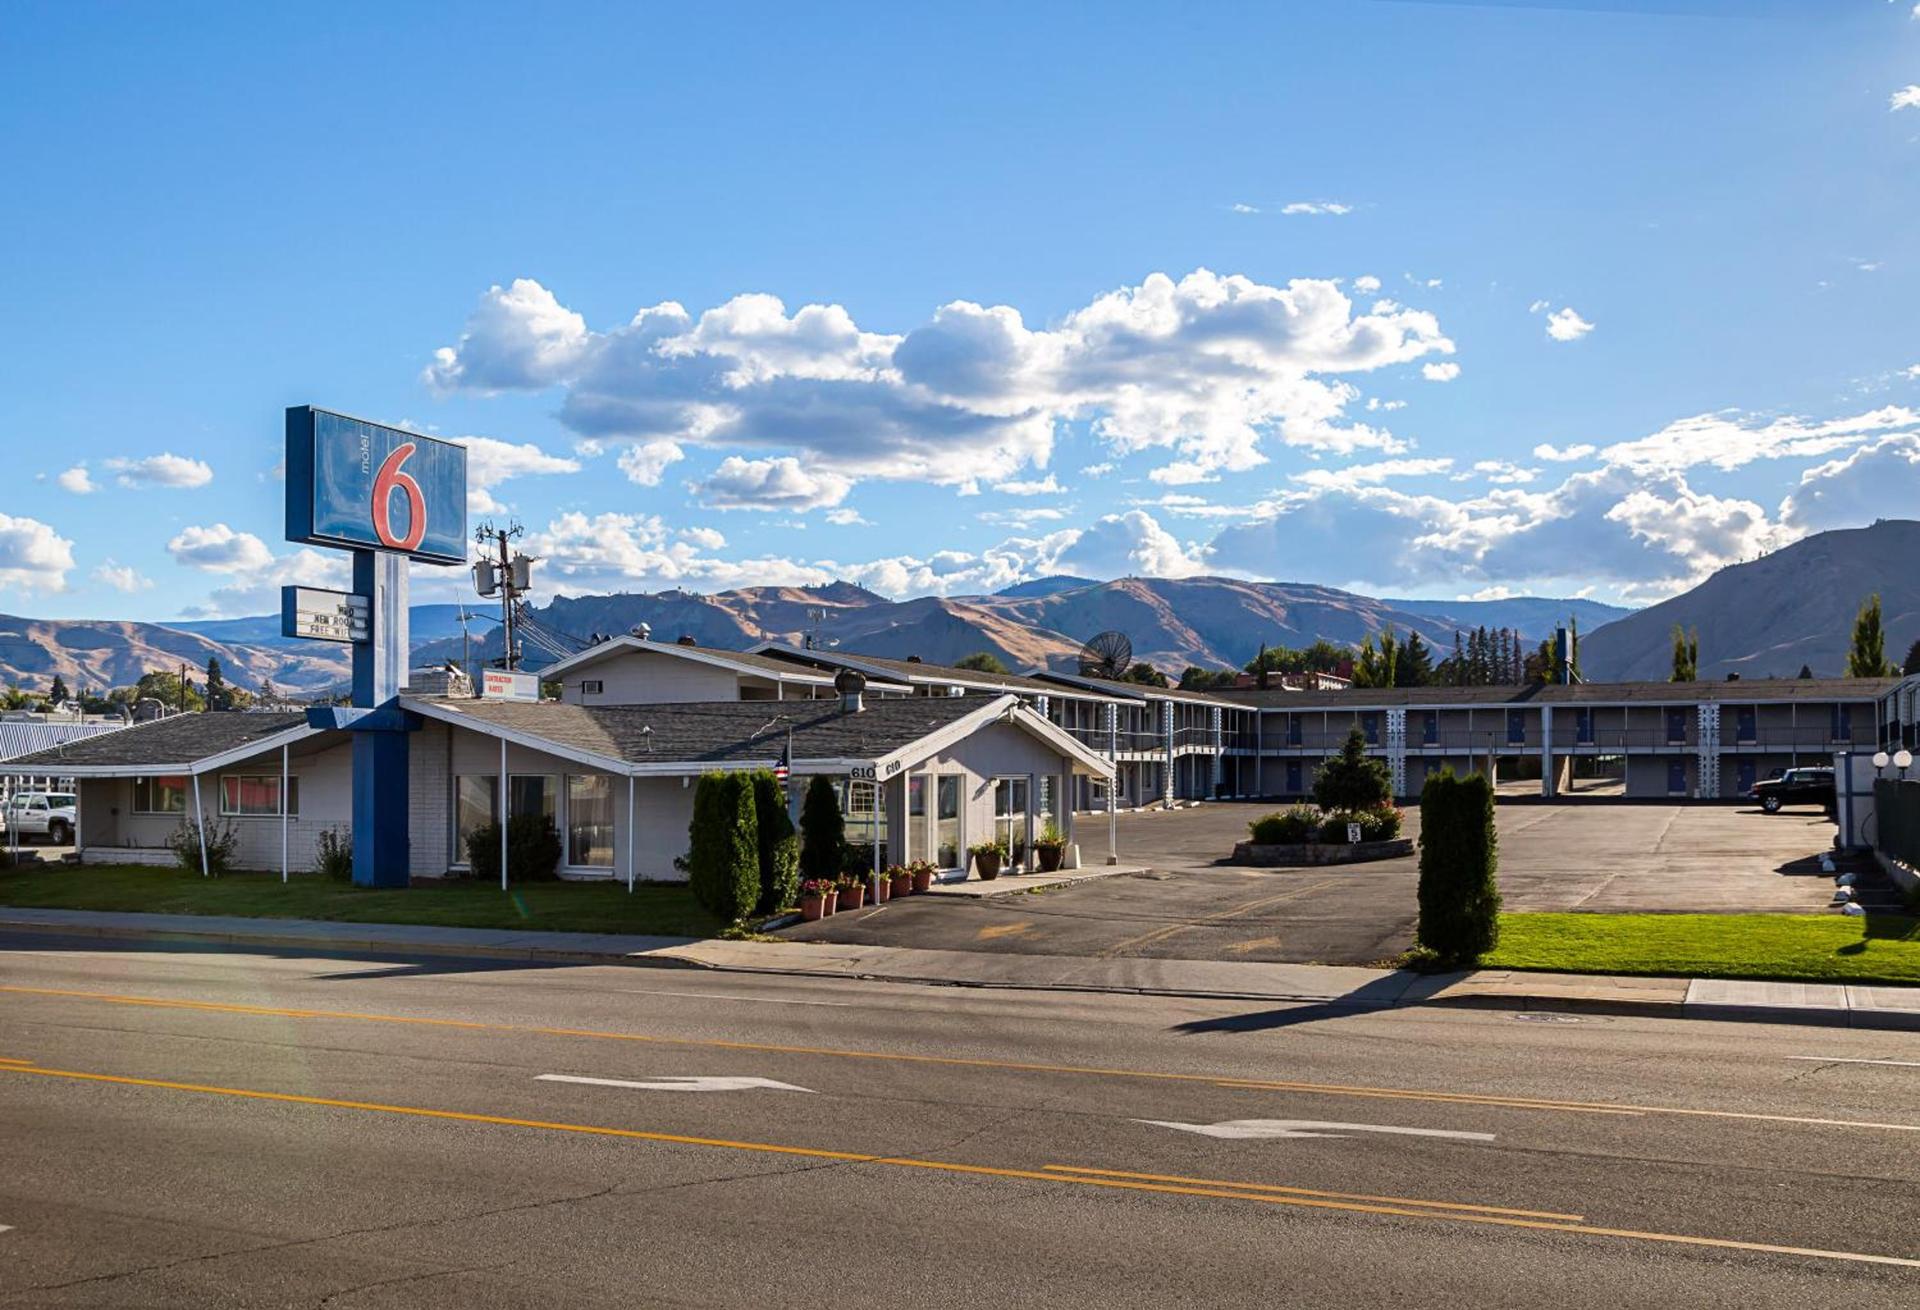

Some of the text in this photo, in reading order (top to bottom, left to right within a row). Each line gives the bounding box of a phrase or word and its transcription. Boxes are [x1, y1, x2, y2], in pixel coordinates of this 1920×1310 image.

[360, 434, 369, 474] motel
[371, 442, 426, 551] 6
[310, 625, 329, 635] FREE
[851, 767, 876, 778] 610
[886, 760, 901, 775] 610
